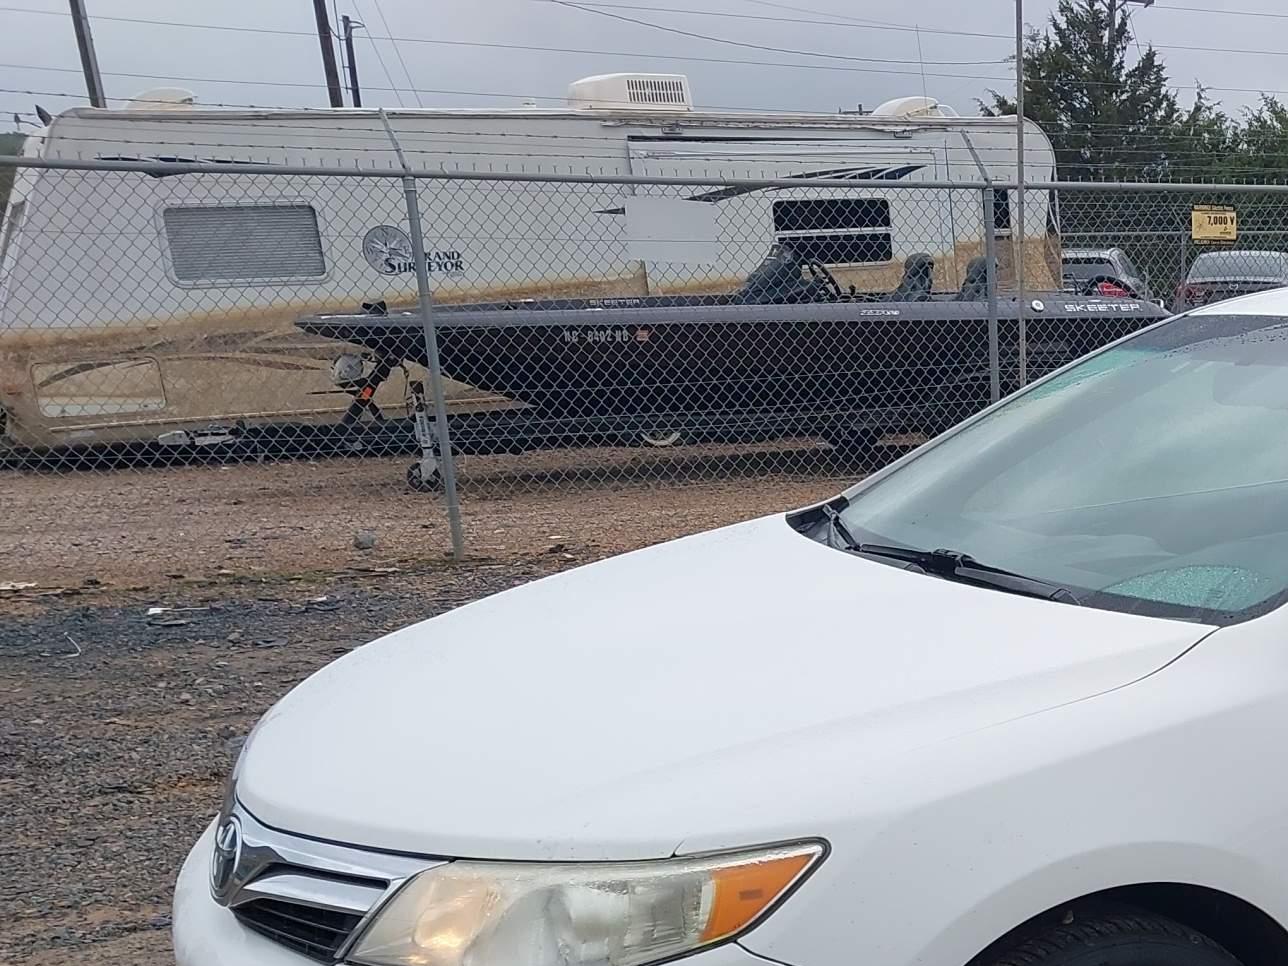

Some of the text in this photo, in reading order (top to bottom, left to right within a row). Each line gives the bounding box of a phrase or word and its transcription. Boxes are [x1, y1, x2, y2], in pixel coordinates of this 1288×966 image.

[1207, 215, 1235, 226] 7,000 V
[423, 250, 461, 261] RAND
[384, 257, 465, 273] SUREYOR
[1064, 303, 1144, 312] SKEETER
